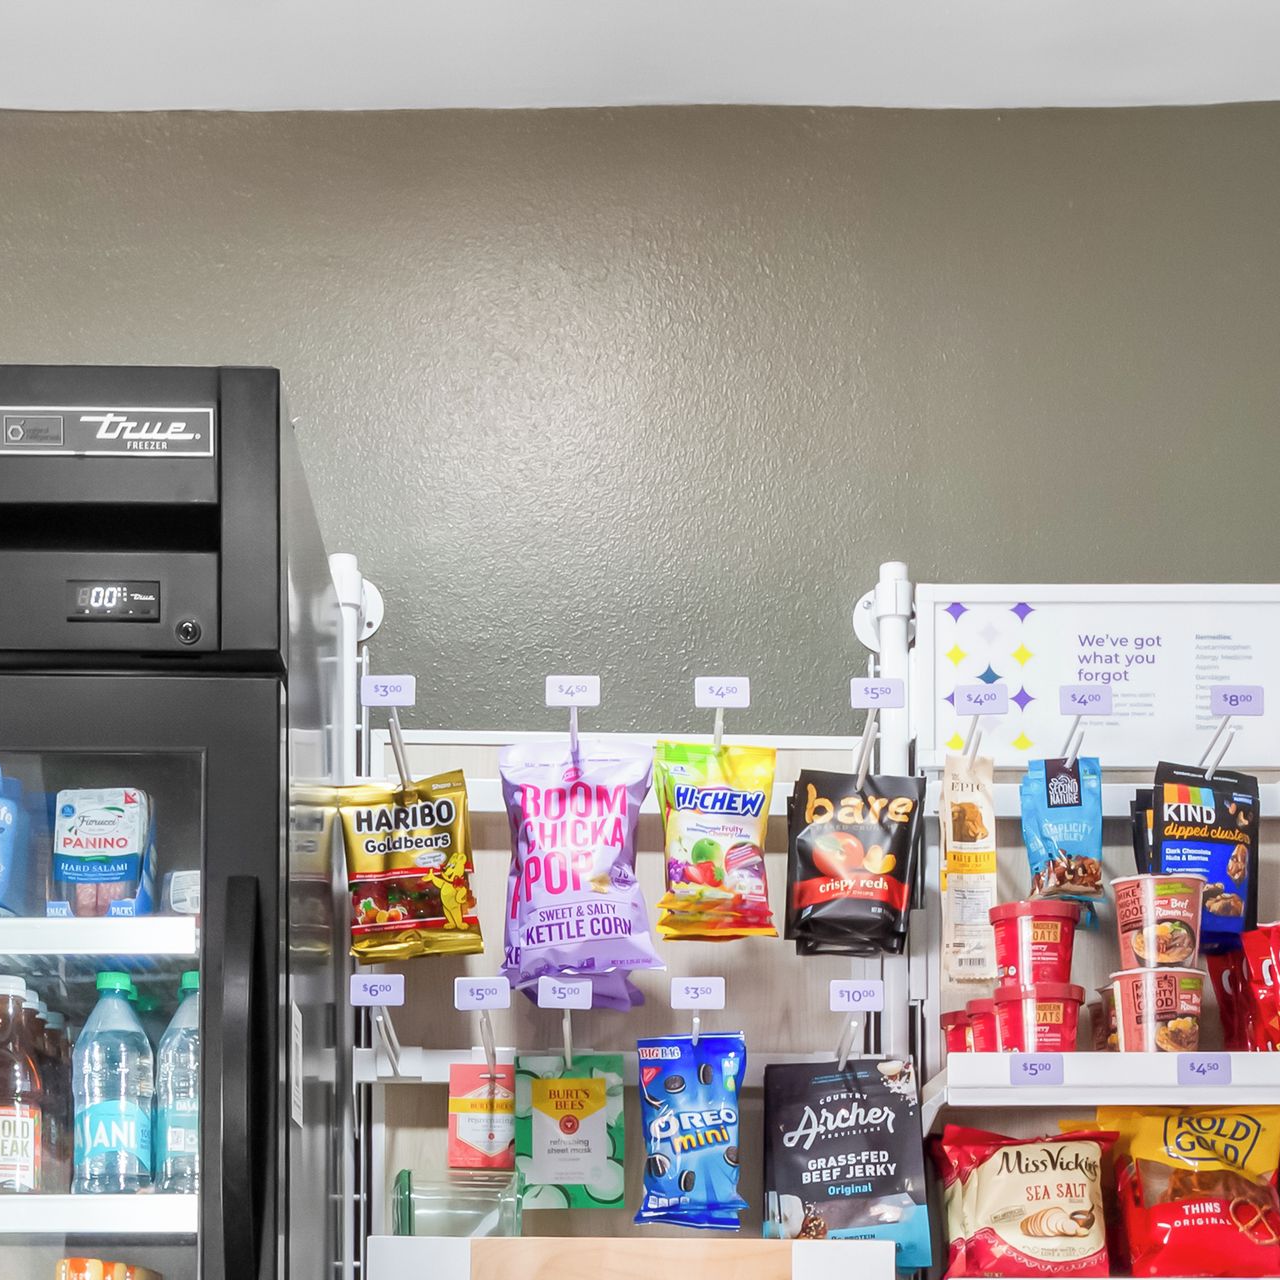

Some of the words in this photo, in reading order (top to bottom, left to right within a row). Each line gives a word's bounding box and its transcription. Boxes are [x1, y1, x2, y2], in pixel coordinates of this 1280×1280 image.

[127, 441, 168, 450] FREEZER
[90, 587, 117, 607] 00
[1078, 634, 1128, 647] We've
[1134, 635, 1162, 650] got
[1078, 651, 1120, 664] what
[1125, 654, 1156, 667] you
[1078, 669, 1129, 684] forgot
[1048, 777, 1079, 794] SECOND
[521, 782, 627, 820] BOOM
[805, 783, 913, 824] bare
[1050, 793, 1079, 805] NATURE
[356, 800, 454, 832] HARIBO
[1164, 804, 1216, 824] KIND
[524, 817, 625, 853] CHICKA
[1164, 822, 1209, 839] dipped
[63, 837, 128, 848] PANINO
[365, 834, 450, 853] Goldbears
[1182, 848, 1212, 856] Chocolate
[61, 863, 90, 873] HARD
[92, 863, 128, 872] SALAMI
[524, 851, 593, 902] POP
[819, 879, 857, 893] crispy
[860, 878, 888, 890] reds
[1171, 898, 1188, 908] Beef
[539, 907, 573, 922] SWEET
[576, 906, 584, 916] &
[587, 904, 616, 916] SALTY
[1155, 907, 1182, 917] Ramen
[526, 920, 586, 945] KETTLE
[590, 917, 632, 936] CORN
[1032, 932, 1058, 941] OATS
[639, 1048, 659, 1059] BIG
[661, 1047, 680, 1058] BAG
[549, 1089, 590, 1099] BURT'S
[820, 1093, 868, 1105] COUNTRY
[555, 1100, 585, 1110] BEES
[650, 1109, 737, 1138] OREO
[783, 1102, 895, 1150] Archer
[1177, 1115, 1251, 1141] ROLD
[673, 1126, 729, 1152] mini
[821, 1127, 881, 1139] PROVISIONS
[1176, 1131, 1239, 1164] GOLD
[808, 1151, 889, 1170] GRASS-FED
[997, 1150, 1047, 1175] Miss
[802, 1168, 841, 1184] BEEF
[846, 1163, 896, 1178] JERKY
[828, 1183, 872, 1195] Original
[1026, 1185, 1051, 1201] SEA
[1056, 1183, 1087, 1198] SALT
[1182, 1203, 1221, 1215] THINS
[1174, 1218, 1232, 1227] ORIGINAL
